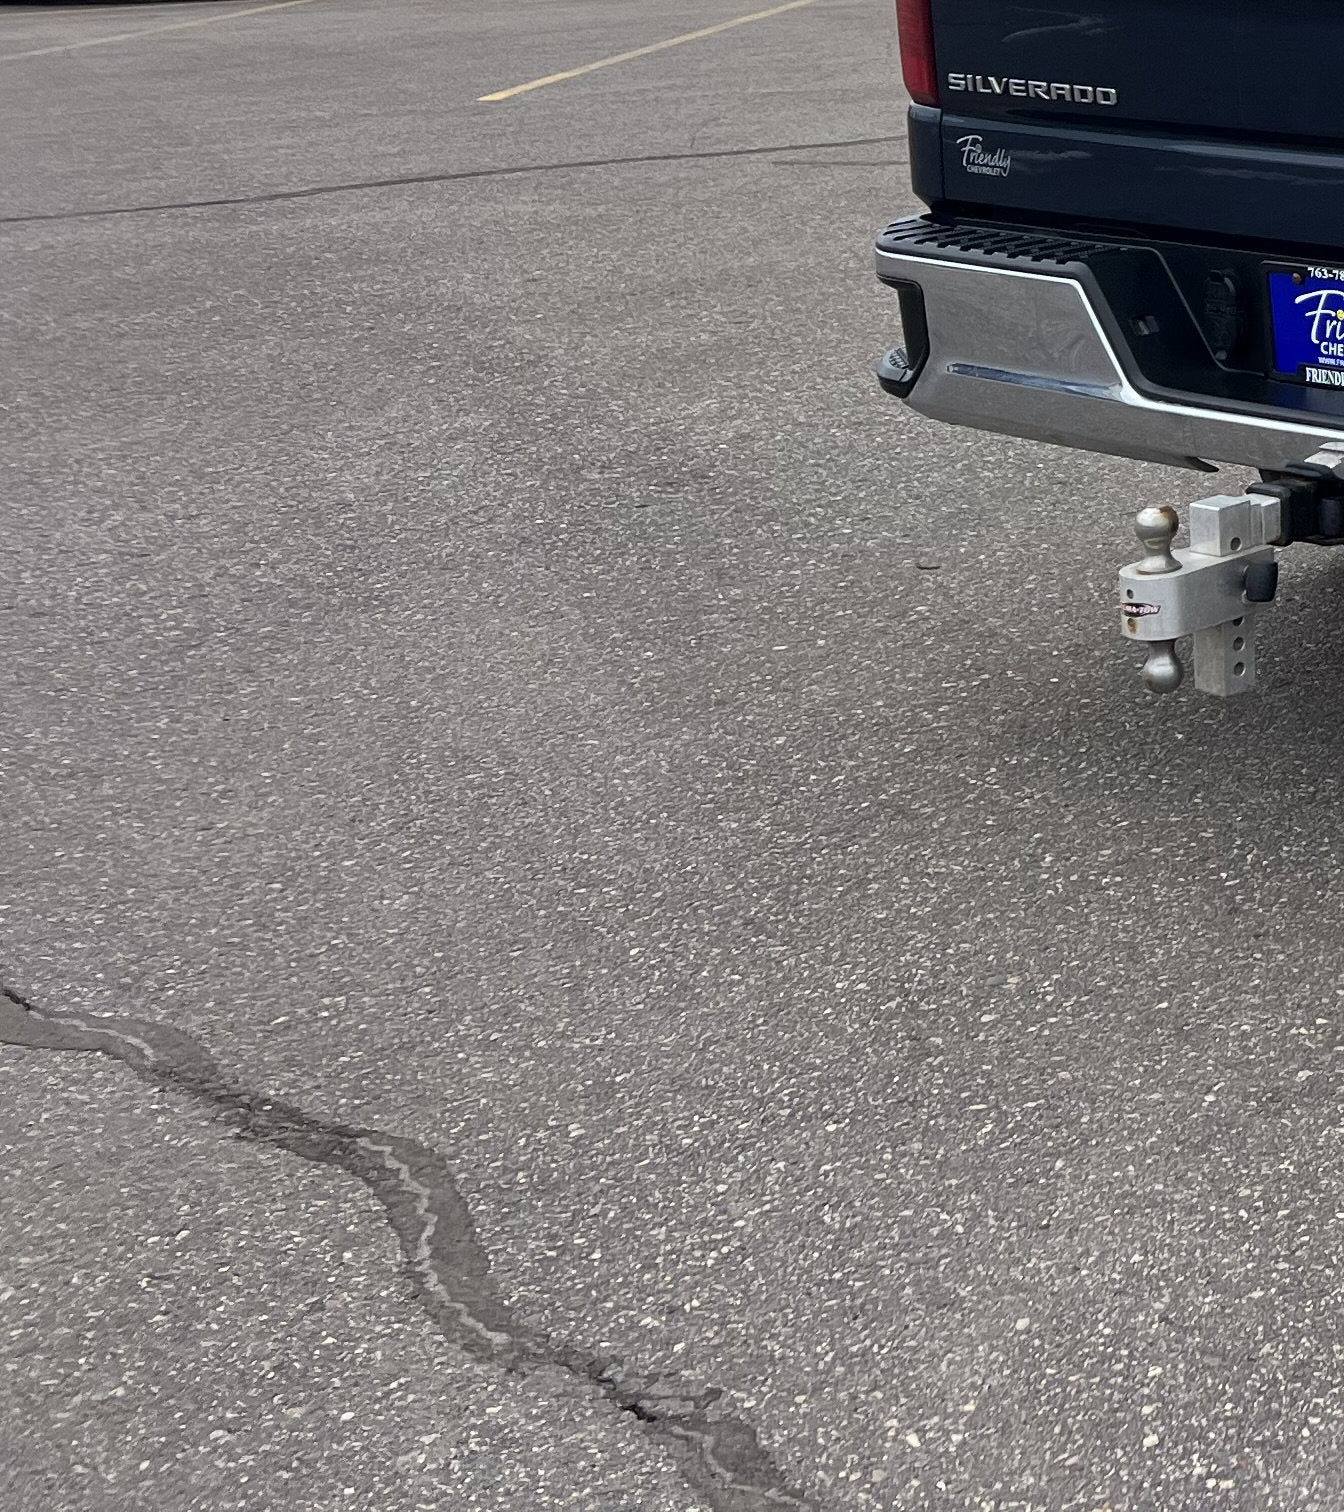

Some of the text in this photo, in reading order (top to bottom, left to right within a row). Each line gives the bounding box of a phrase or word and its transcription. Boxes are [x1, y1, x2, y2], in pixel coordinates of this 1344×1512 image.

[947, 73, 1118, 106] SILVERADO
[956, 135, 1011, 177] Friendly
[966, 165, 1001, 176] CHEVROLET
